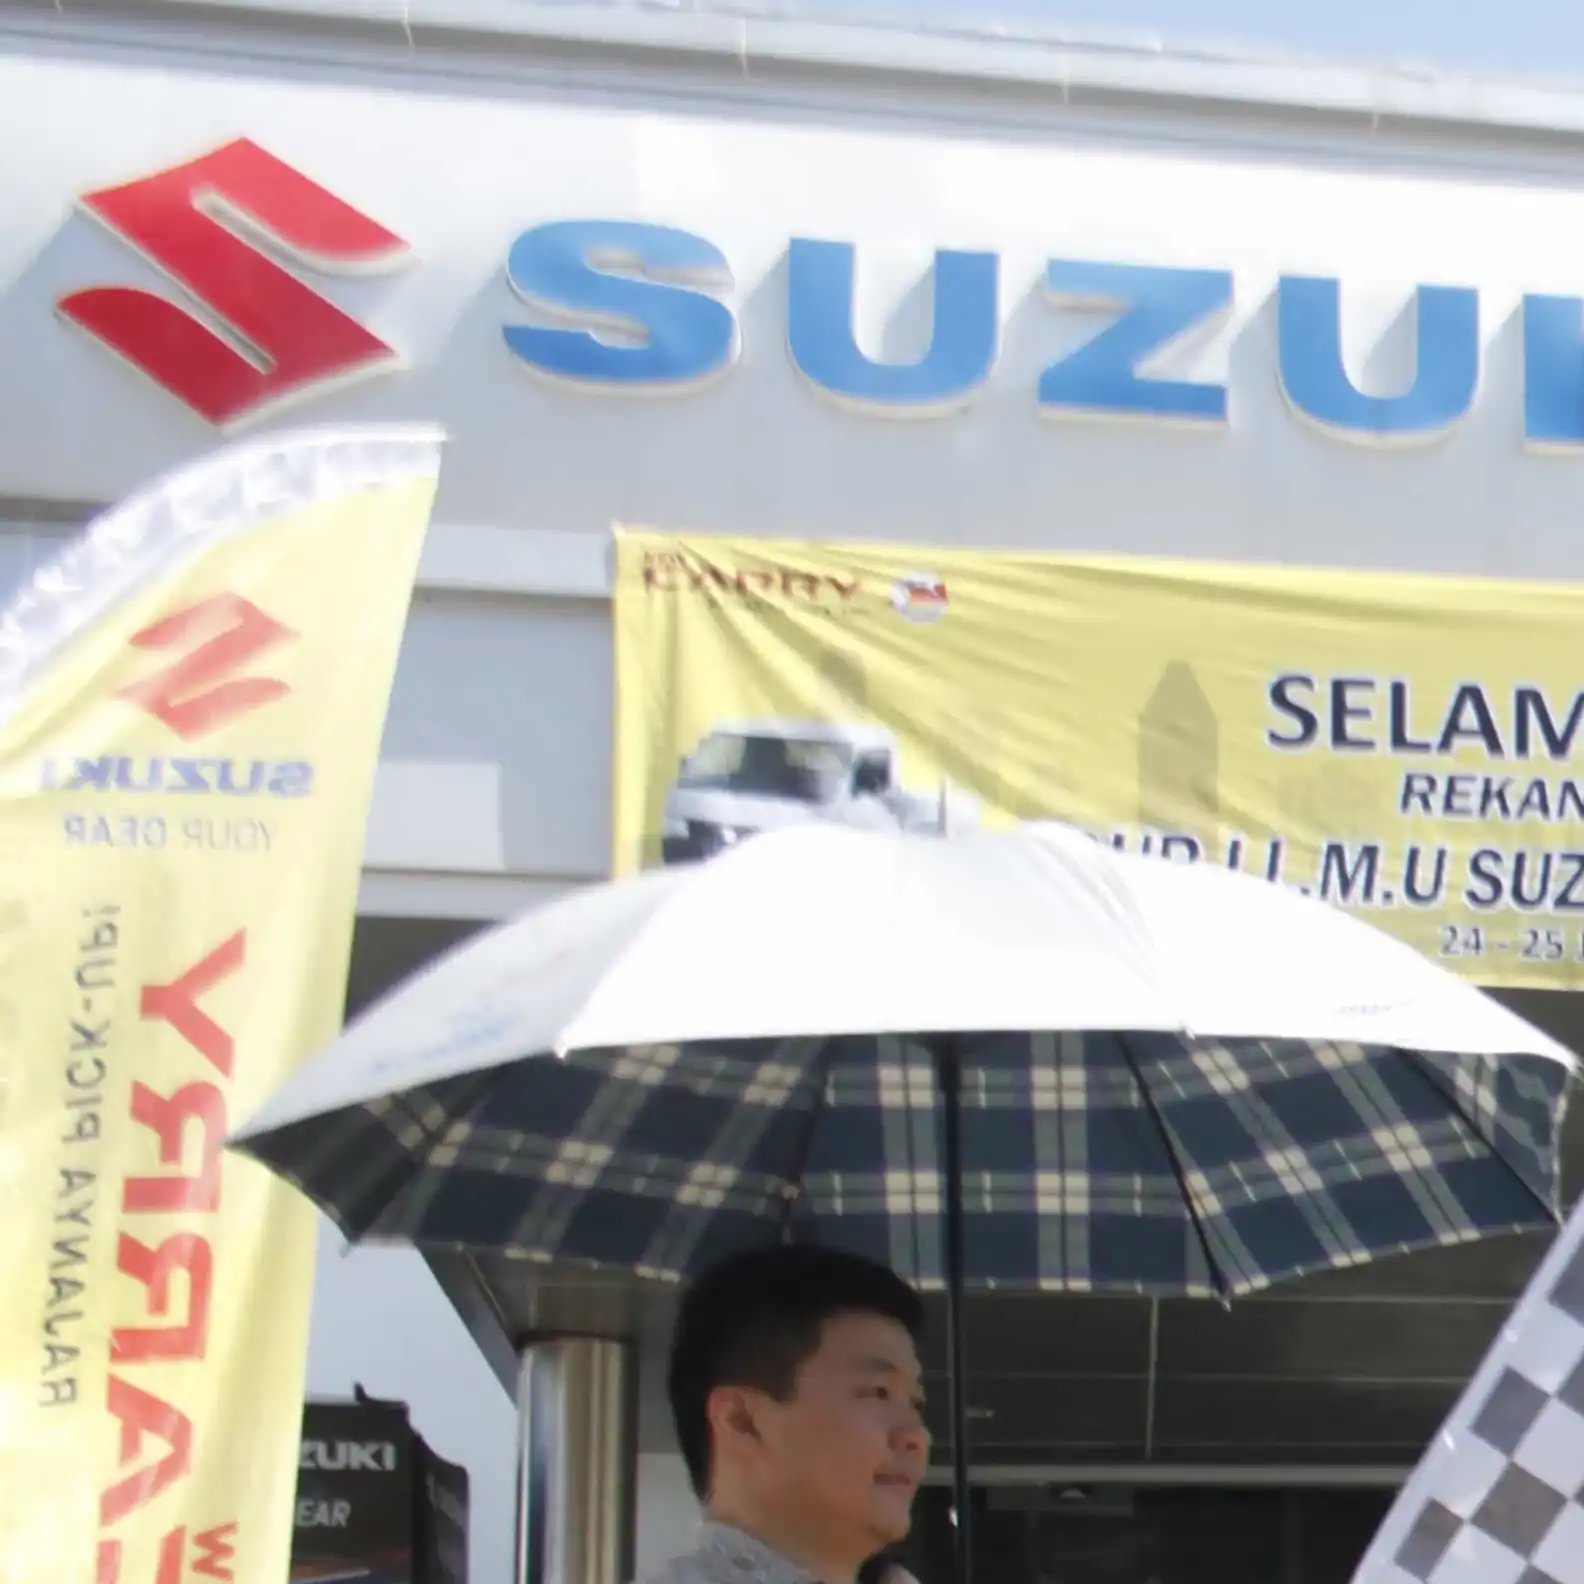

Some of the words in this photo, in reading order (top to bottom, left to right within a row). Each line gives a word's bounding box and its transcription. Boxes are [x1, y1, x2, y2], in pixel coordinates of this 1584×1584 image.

[1441, 927, 1483, 956] 24
[1523, 929, 1564, 959] 25
[298, 1439, 397, 1471] ZUKI
[295, 1498, 353, 1529] EAR
